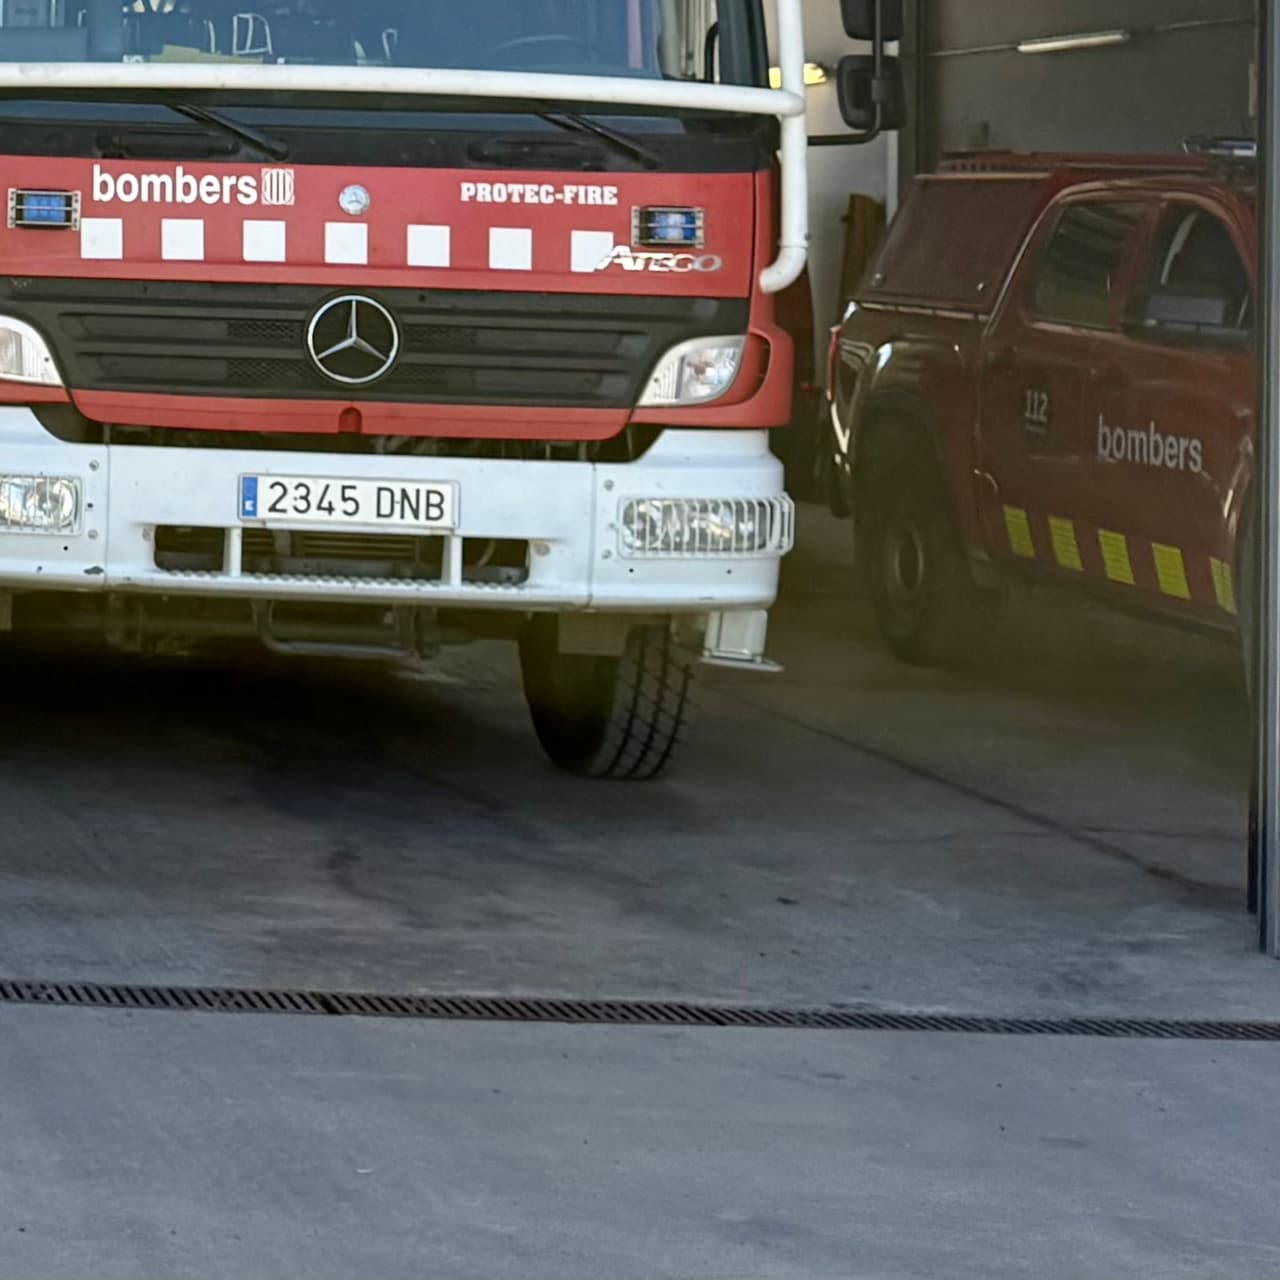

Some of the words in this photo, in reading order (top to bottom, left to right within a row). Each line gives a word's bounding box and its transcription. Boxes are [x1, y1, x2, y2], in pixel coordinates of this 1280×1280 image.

[93, 164, 258, 204] bombers
[460, 182, 618, 206] PROTEC-FIRE
[1024, 389, 1049, 422] 112
[1097, 412, 1202, 473] bombers
[267, 481, 360, 517] 2345
[376, 486, 445, 521] DNB
